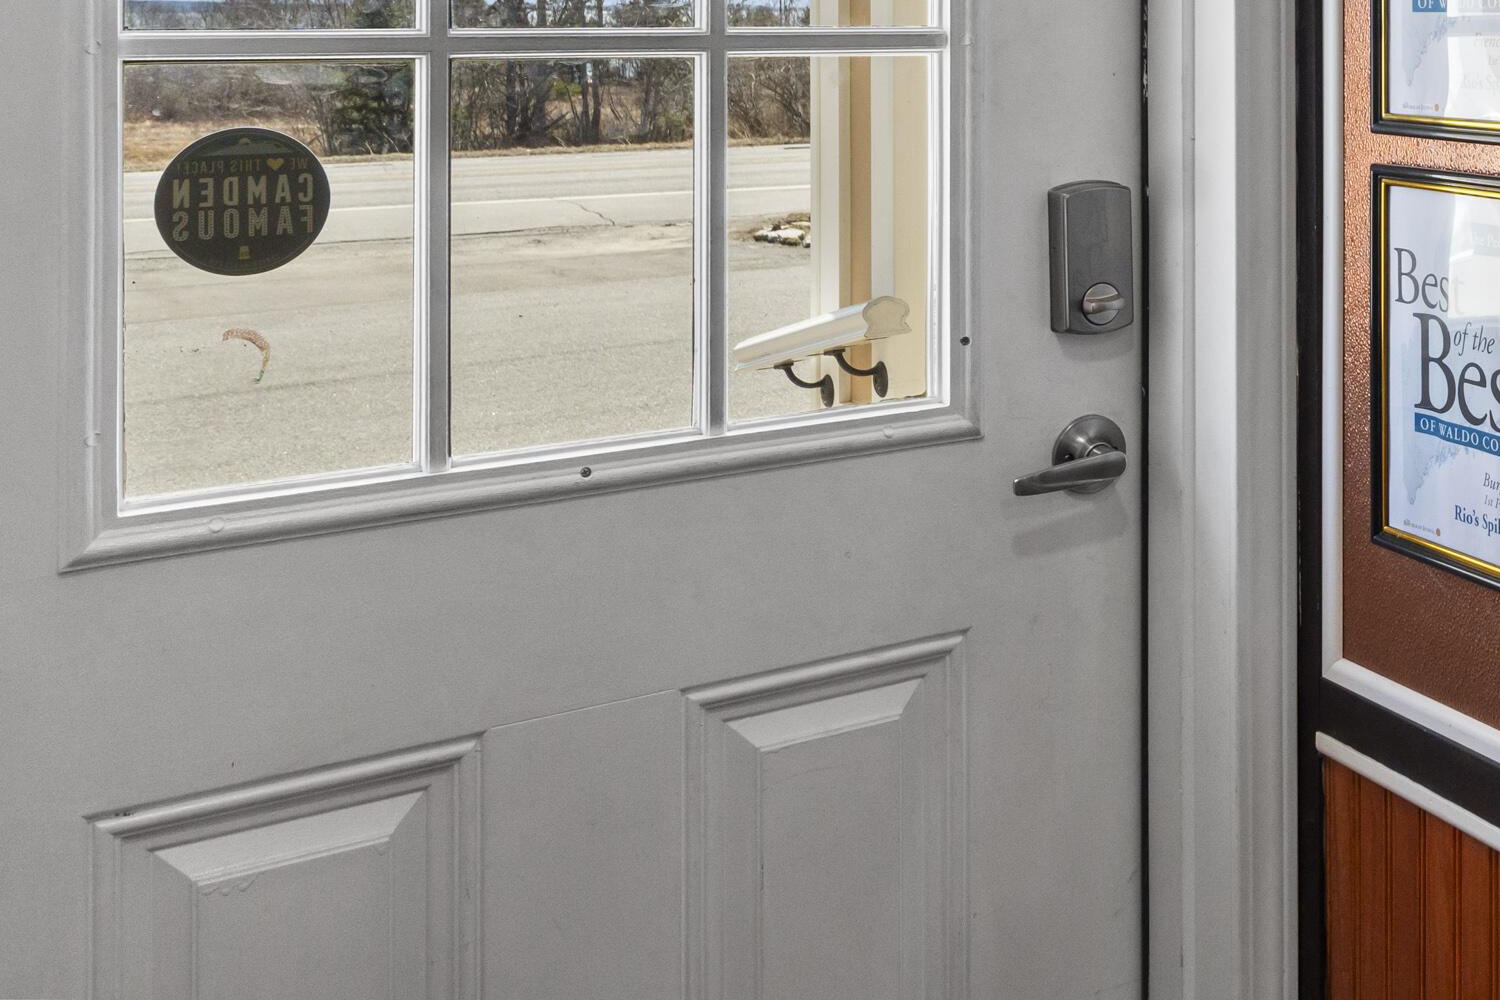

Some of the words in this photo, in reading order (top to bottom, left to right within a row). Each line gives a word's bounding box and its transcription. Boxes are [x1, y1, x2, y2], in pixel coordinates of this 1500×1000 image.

[1454, 322, 1471, 356] of
[1473, 325, 1495, 354] the
[1420, 418, 1436, 431] OF
[1439, 423, 1479, 445] WALDO
[1485, 495, 1494, 508] 1st
[1455, 505, 1479, 527] Rio's
